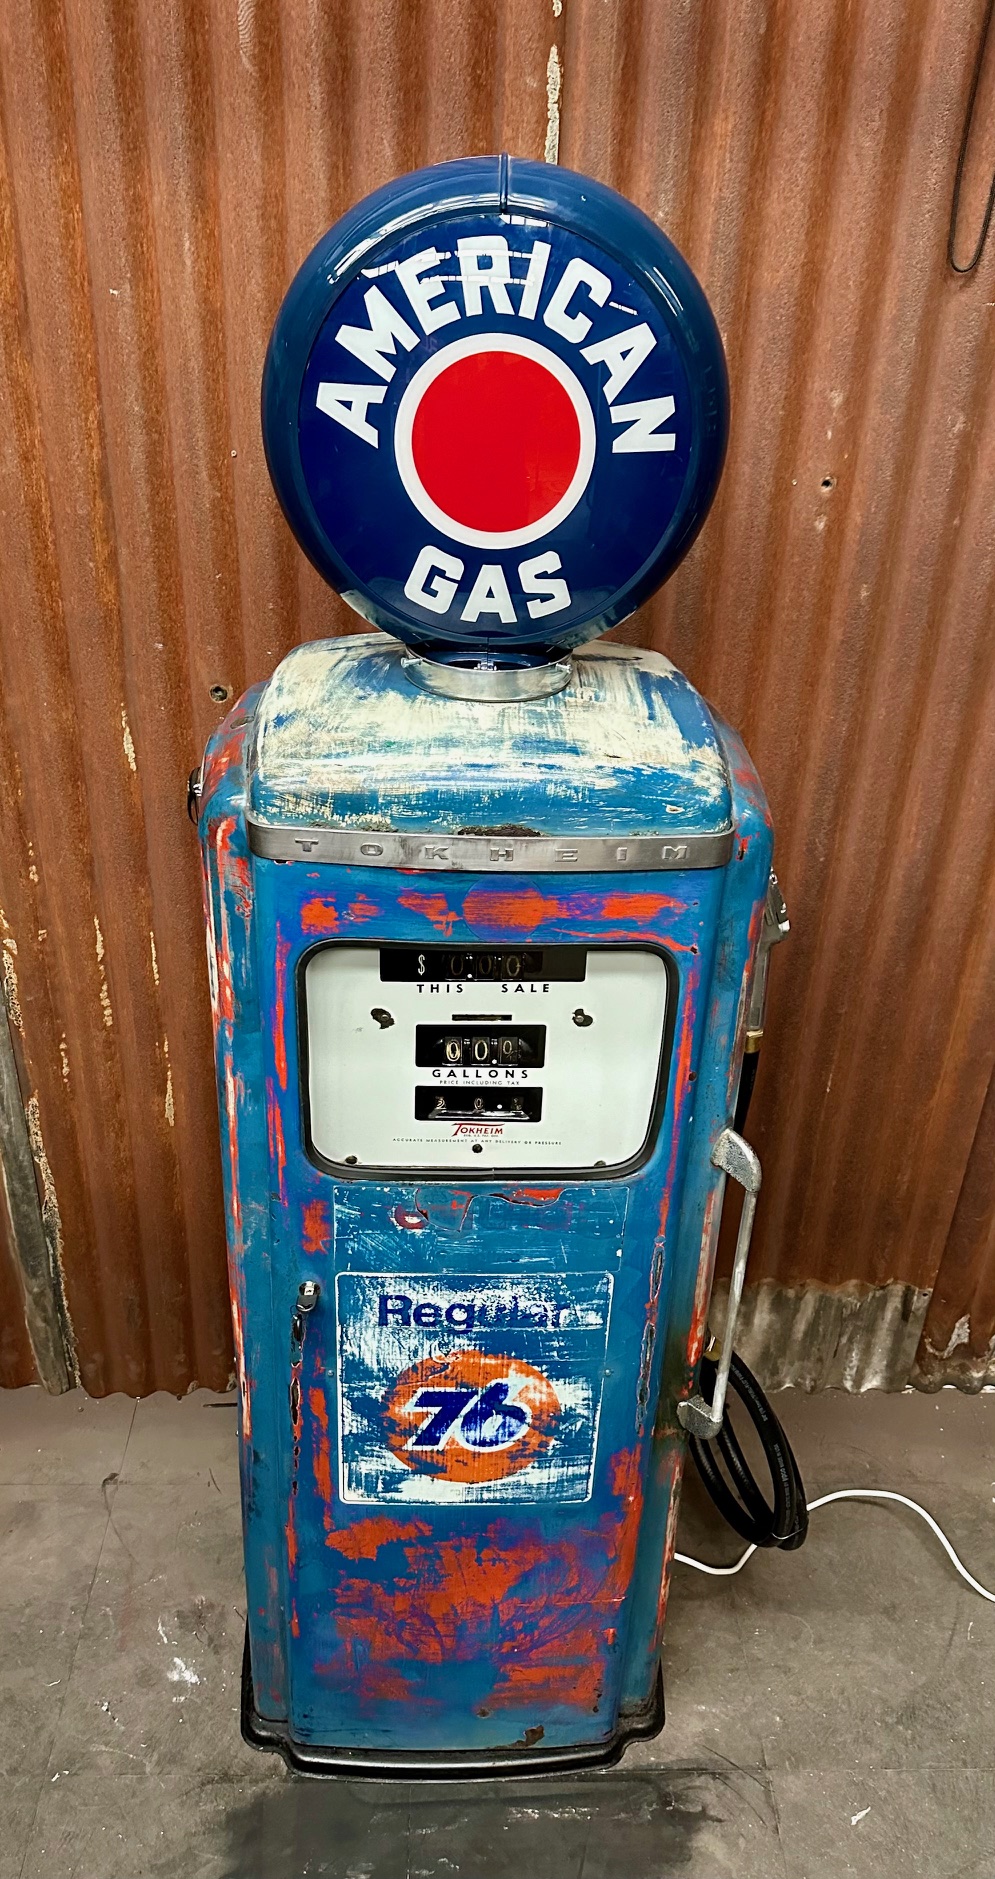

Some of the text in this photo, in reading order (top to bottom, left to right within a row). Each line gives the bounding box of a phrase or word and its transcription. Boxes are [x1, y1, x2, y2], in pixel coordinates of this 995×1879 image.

[315, 235, 676, 453] AMERICAN
[404, 545, 571, 624] GAS
[294, 838, 689, 863] TOKHEIM
[416, 983, 550, 993] THIS SALE
[432, 1069, 528, 1079] GALLONS
[403, 1379, 531, 1452] 76
